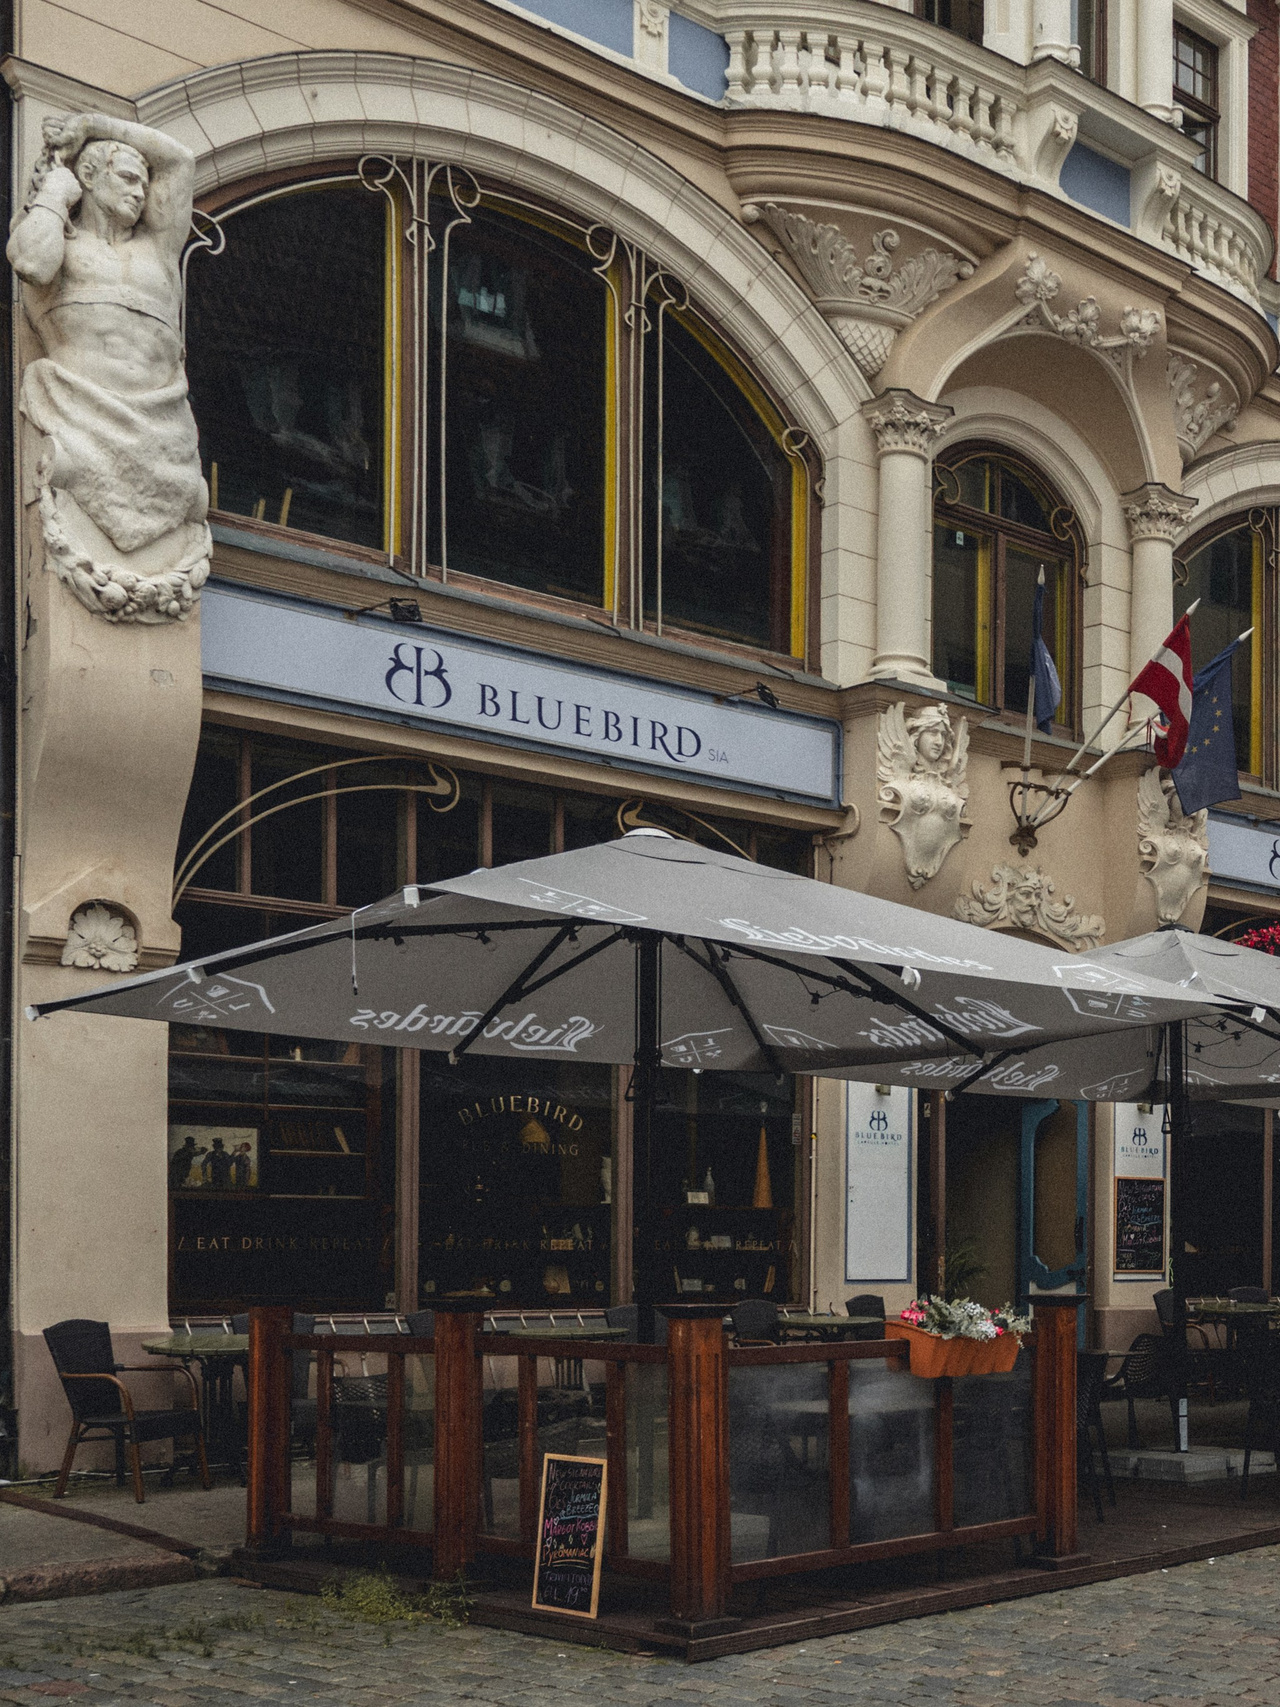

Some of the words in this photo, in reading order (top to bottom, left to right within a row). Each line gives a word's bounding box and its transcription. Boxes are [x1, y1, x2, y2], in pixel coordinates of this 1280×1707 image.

[477, 683, 702, 763] BLUEBIRD
[708, 748, 729, 764] SIA
[458, 1095, 584, 1132] BLUEBIRD
[522, 1142, 580, 1156] DINING
[196, 1235, 231, 1251] EAT
[241, 1235, 298, 1251] DRINK
